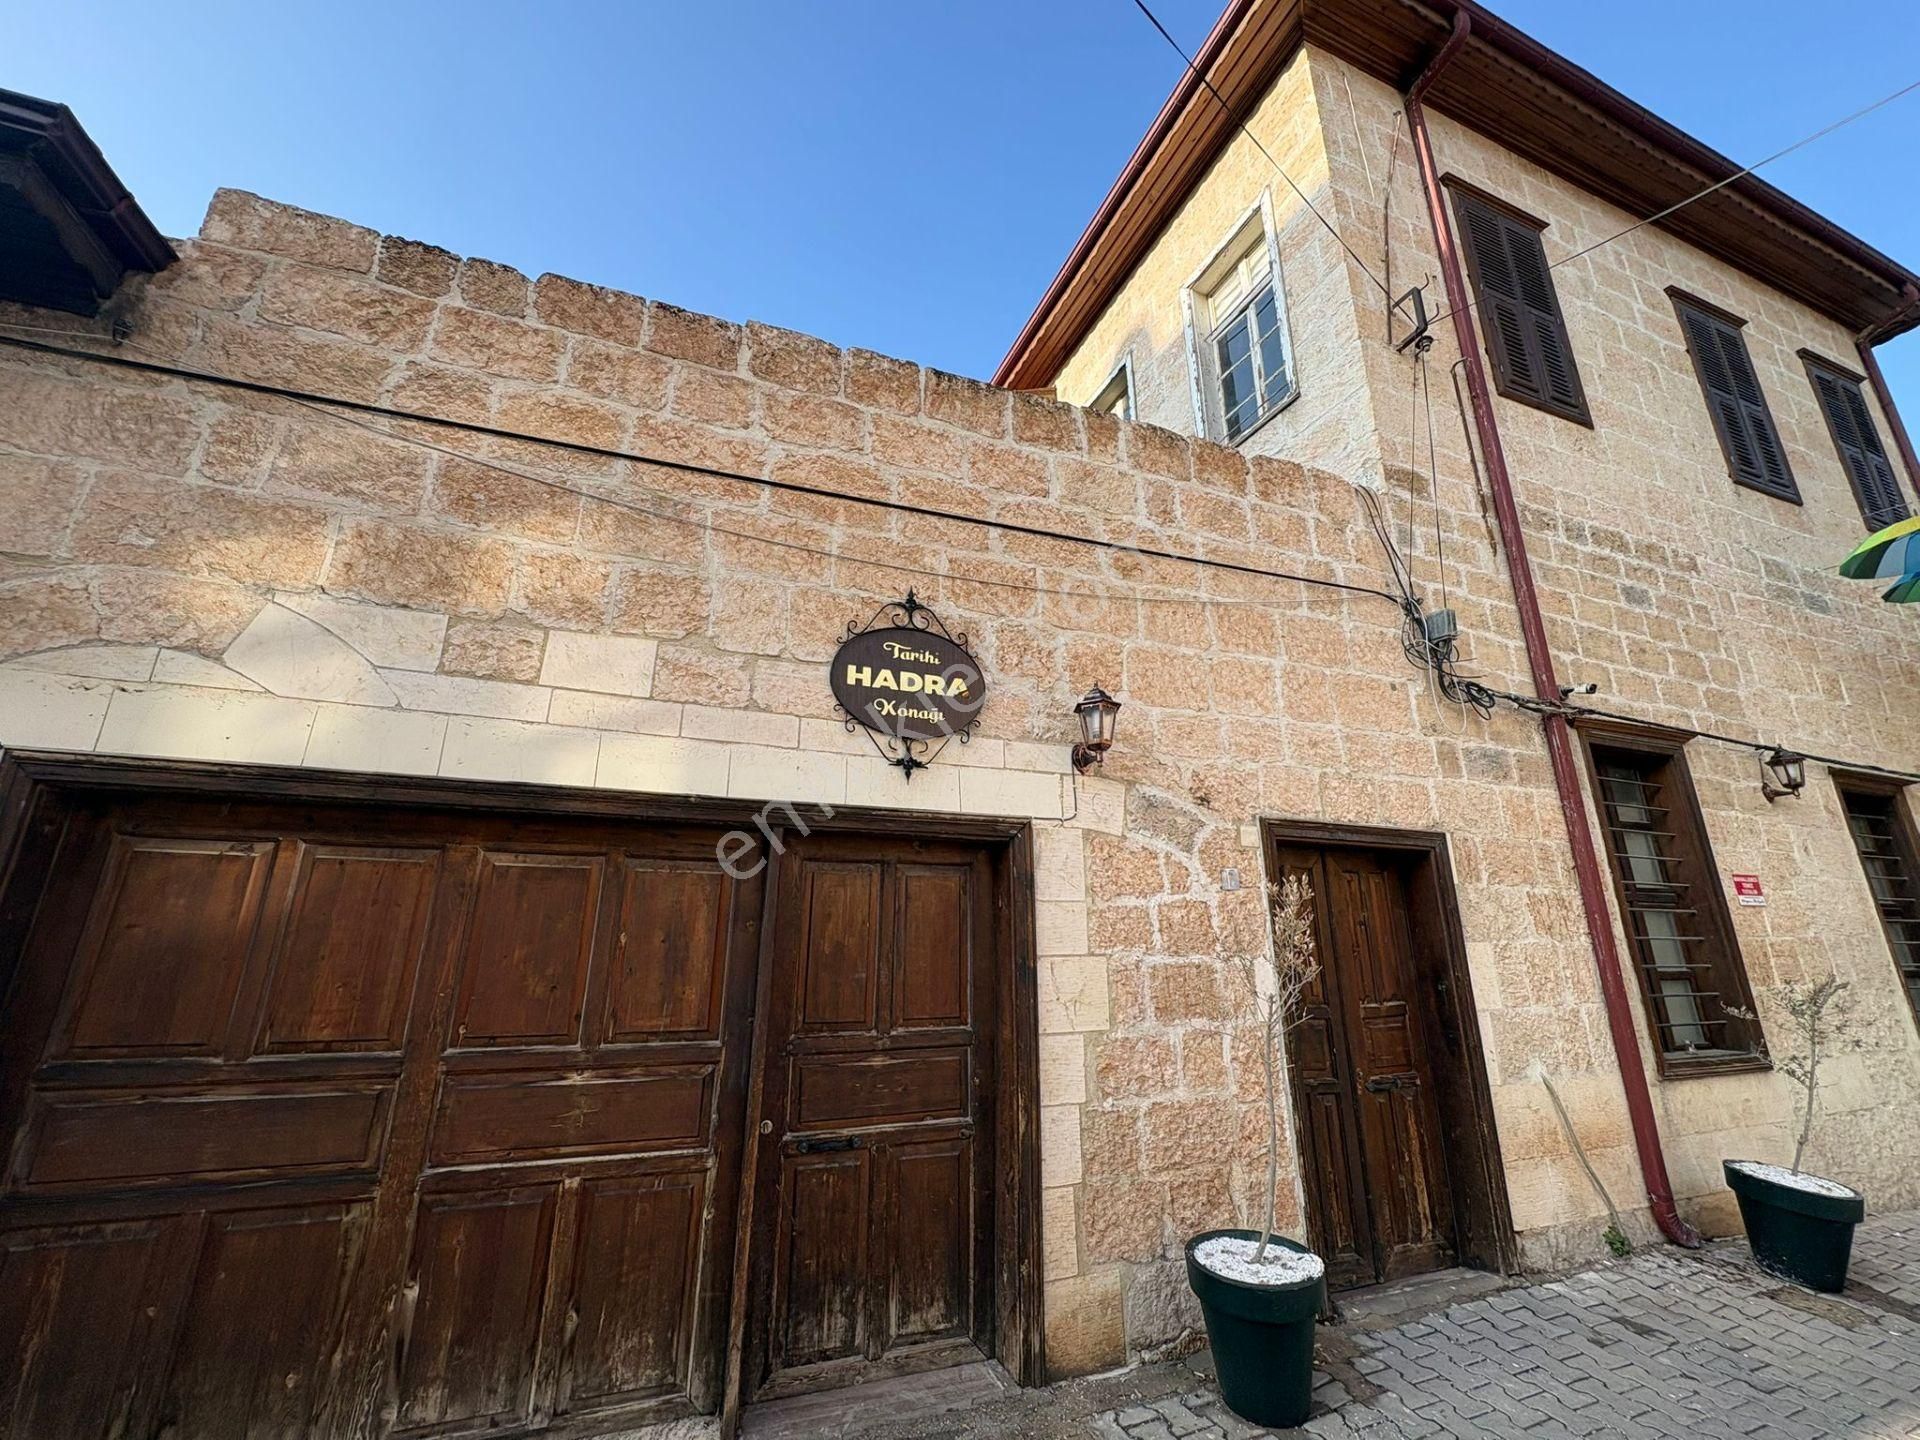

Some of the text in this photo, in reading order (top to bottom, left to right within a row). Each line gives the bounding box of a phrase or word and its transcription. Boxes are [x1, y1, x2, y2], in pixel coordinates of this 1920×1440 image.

[883, 641, 942, 665] Tarihi
[846, 664, 970, 699] HADRA
[873, 697, 945, 724] Konağı
